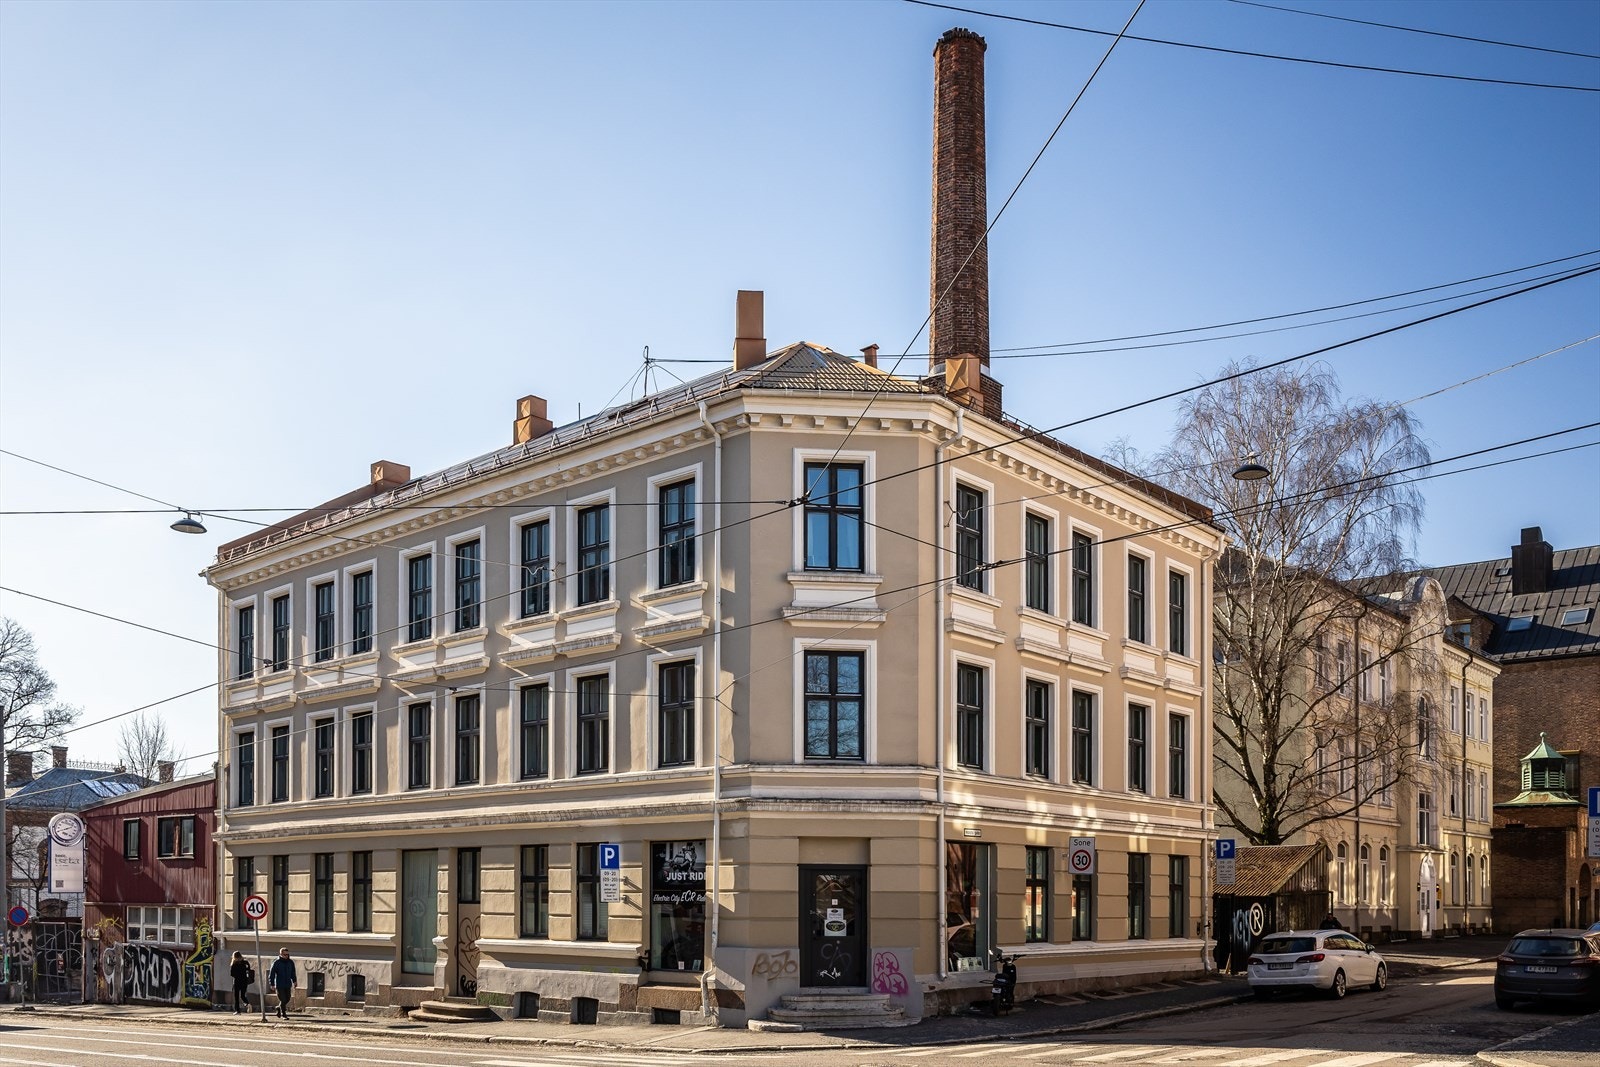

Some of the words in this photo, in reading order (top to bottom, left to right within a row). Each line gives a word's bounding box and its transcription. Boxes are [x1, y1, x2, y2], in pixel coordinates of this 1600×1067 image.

[1220, 841, 1231, 857] P
[605, 847, 615, 866] P
[1075, 855, 1088, 866] 30
[666, 872, 688, 881] JUST
[248, 902, 264, 914] 40
